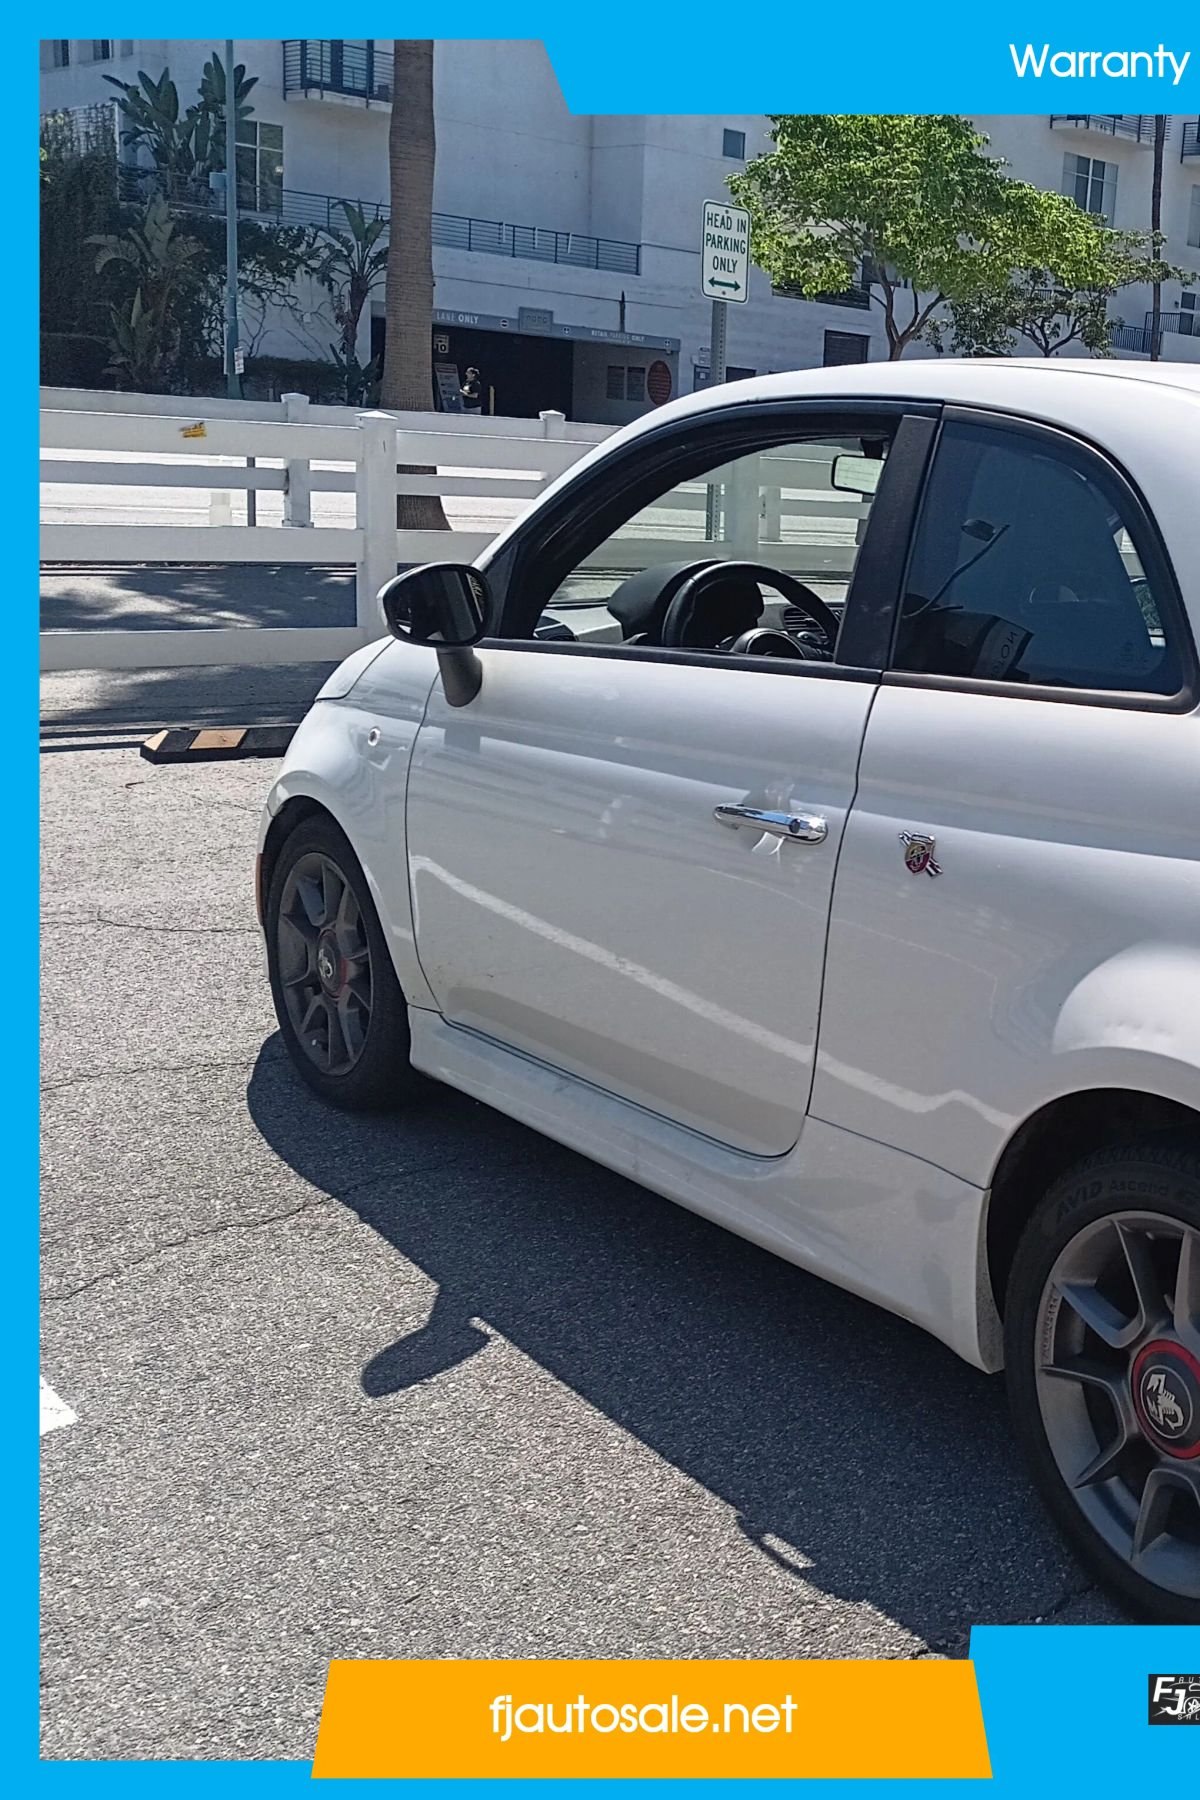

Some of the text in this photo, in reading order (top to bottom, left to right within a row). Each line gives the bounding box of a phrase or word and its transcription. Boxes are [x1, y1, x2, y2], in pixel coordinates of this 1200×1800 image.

[707, 211, 747, 233] HEAD IN
[705, 233, 746, 254] PARKING
[712, 256, 738, 273] ONLY
[458, 313, 479, 325] ONLY
